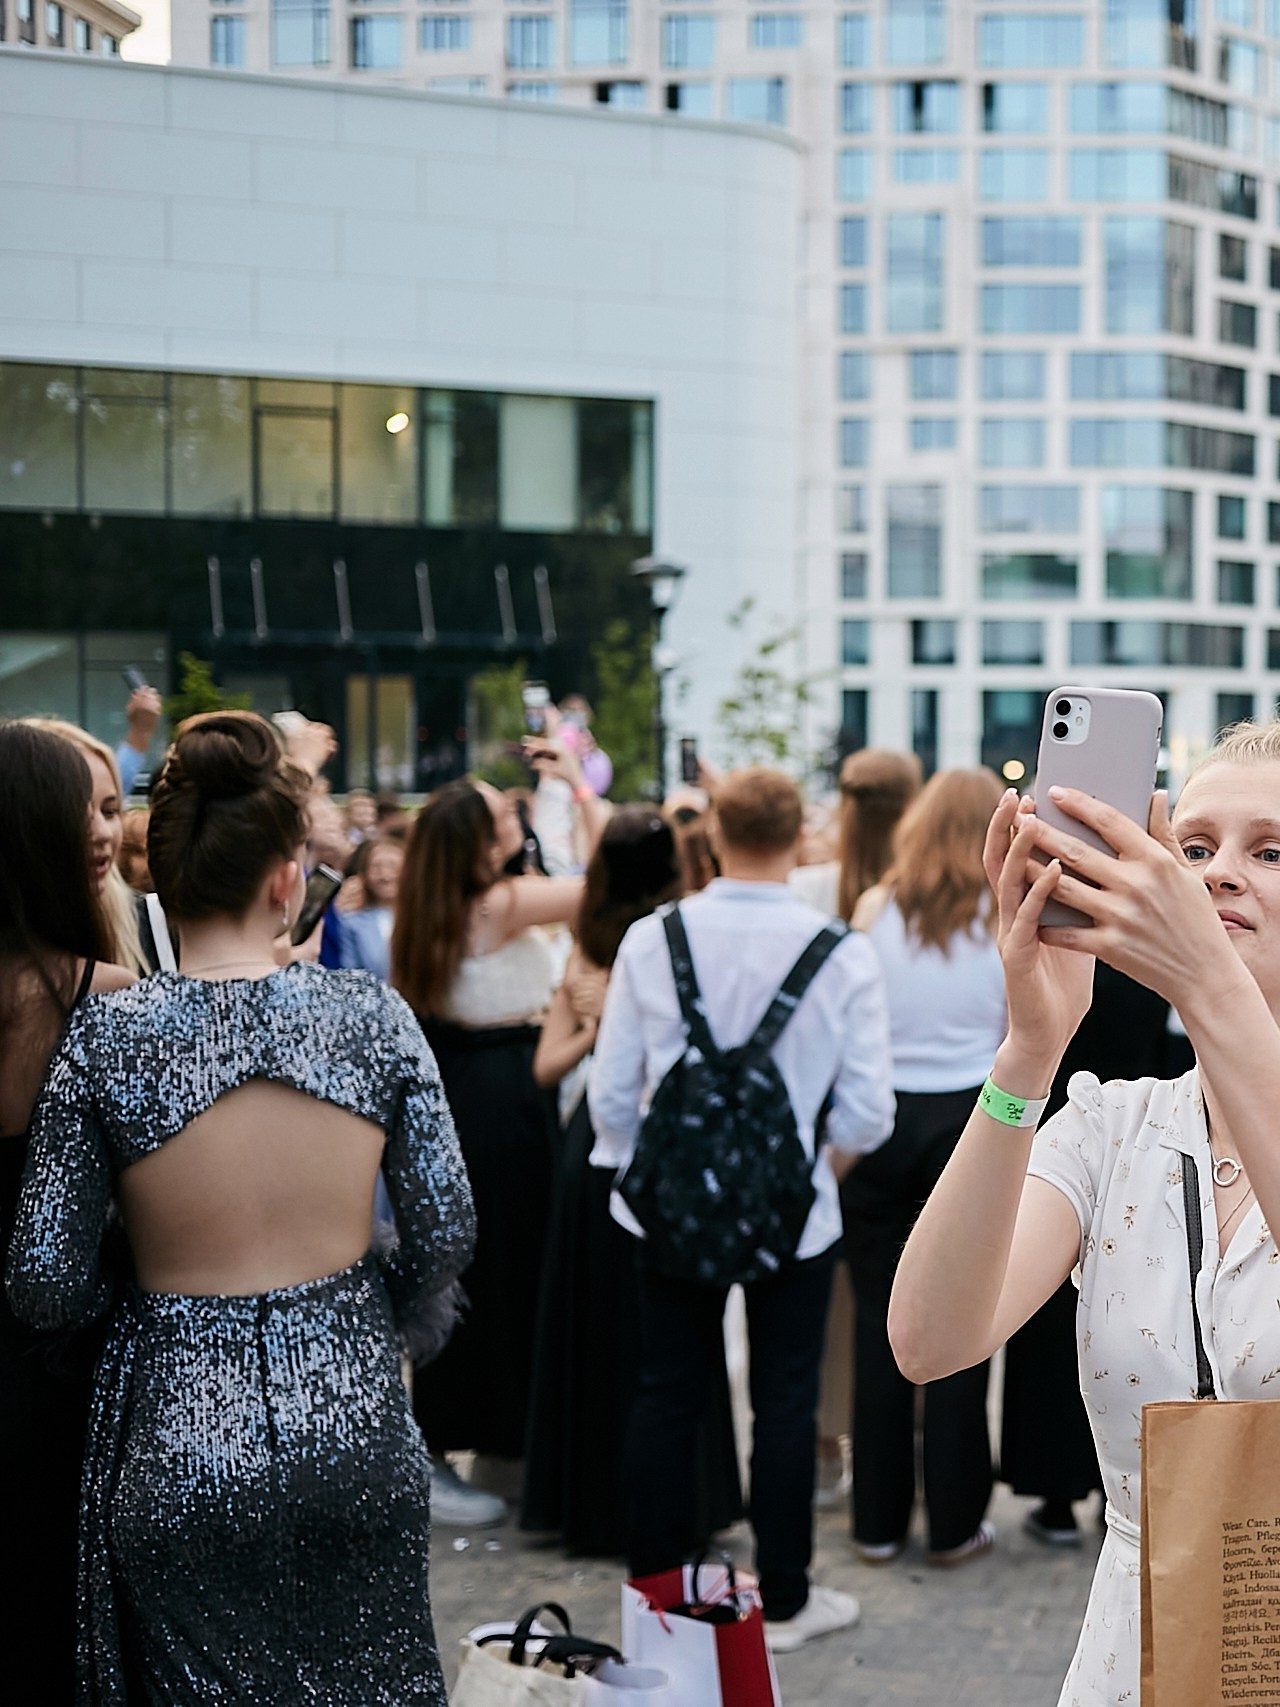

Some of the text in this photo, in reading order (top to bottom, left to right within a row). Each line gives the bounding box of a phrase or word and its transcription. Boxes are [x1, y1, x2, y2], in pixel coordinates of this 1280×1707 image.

[1222, 1521, 1243, 1531] Wear.
[1247, 1518, 1270, 1528] Care.
[1222, 1534, 1252, 1545] Tragen.
[1222, 1636, 1249, 1648] Neguj.
[1251, 1661, 1271, 1671] Sóc.
[1221, 1675, 1258, 1687] Recycle.
